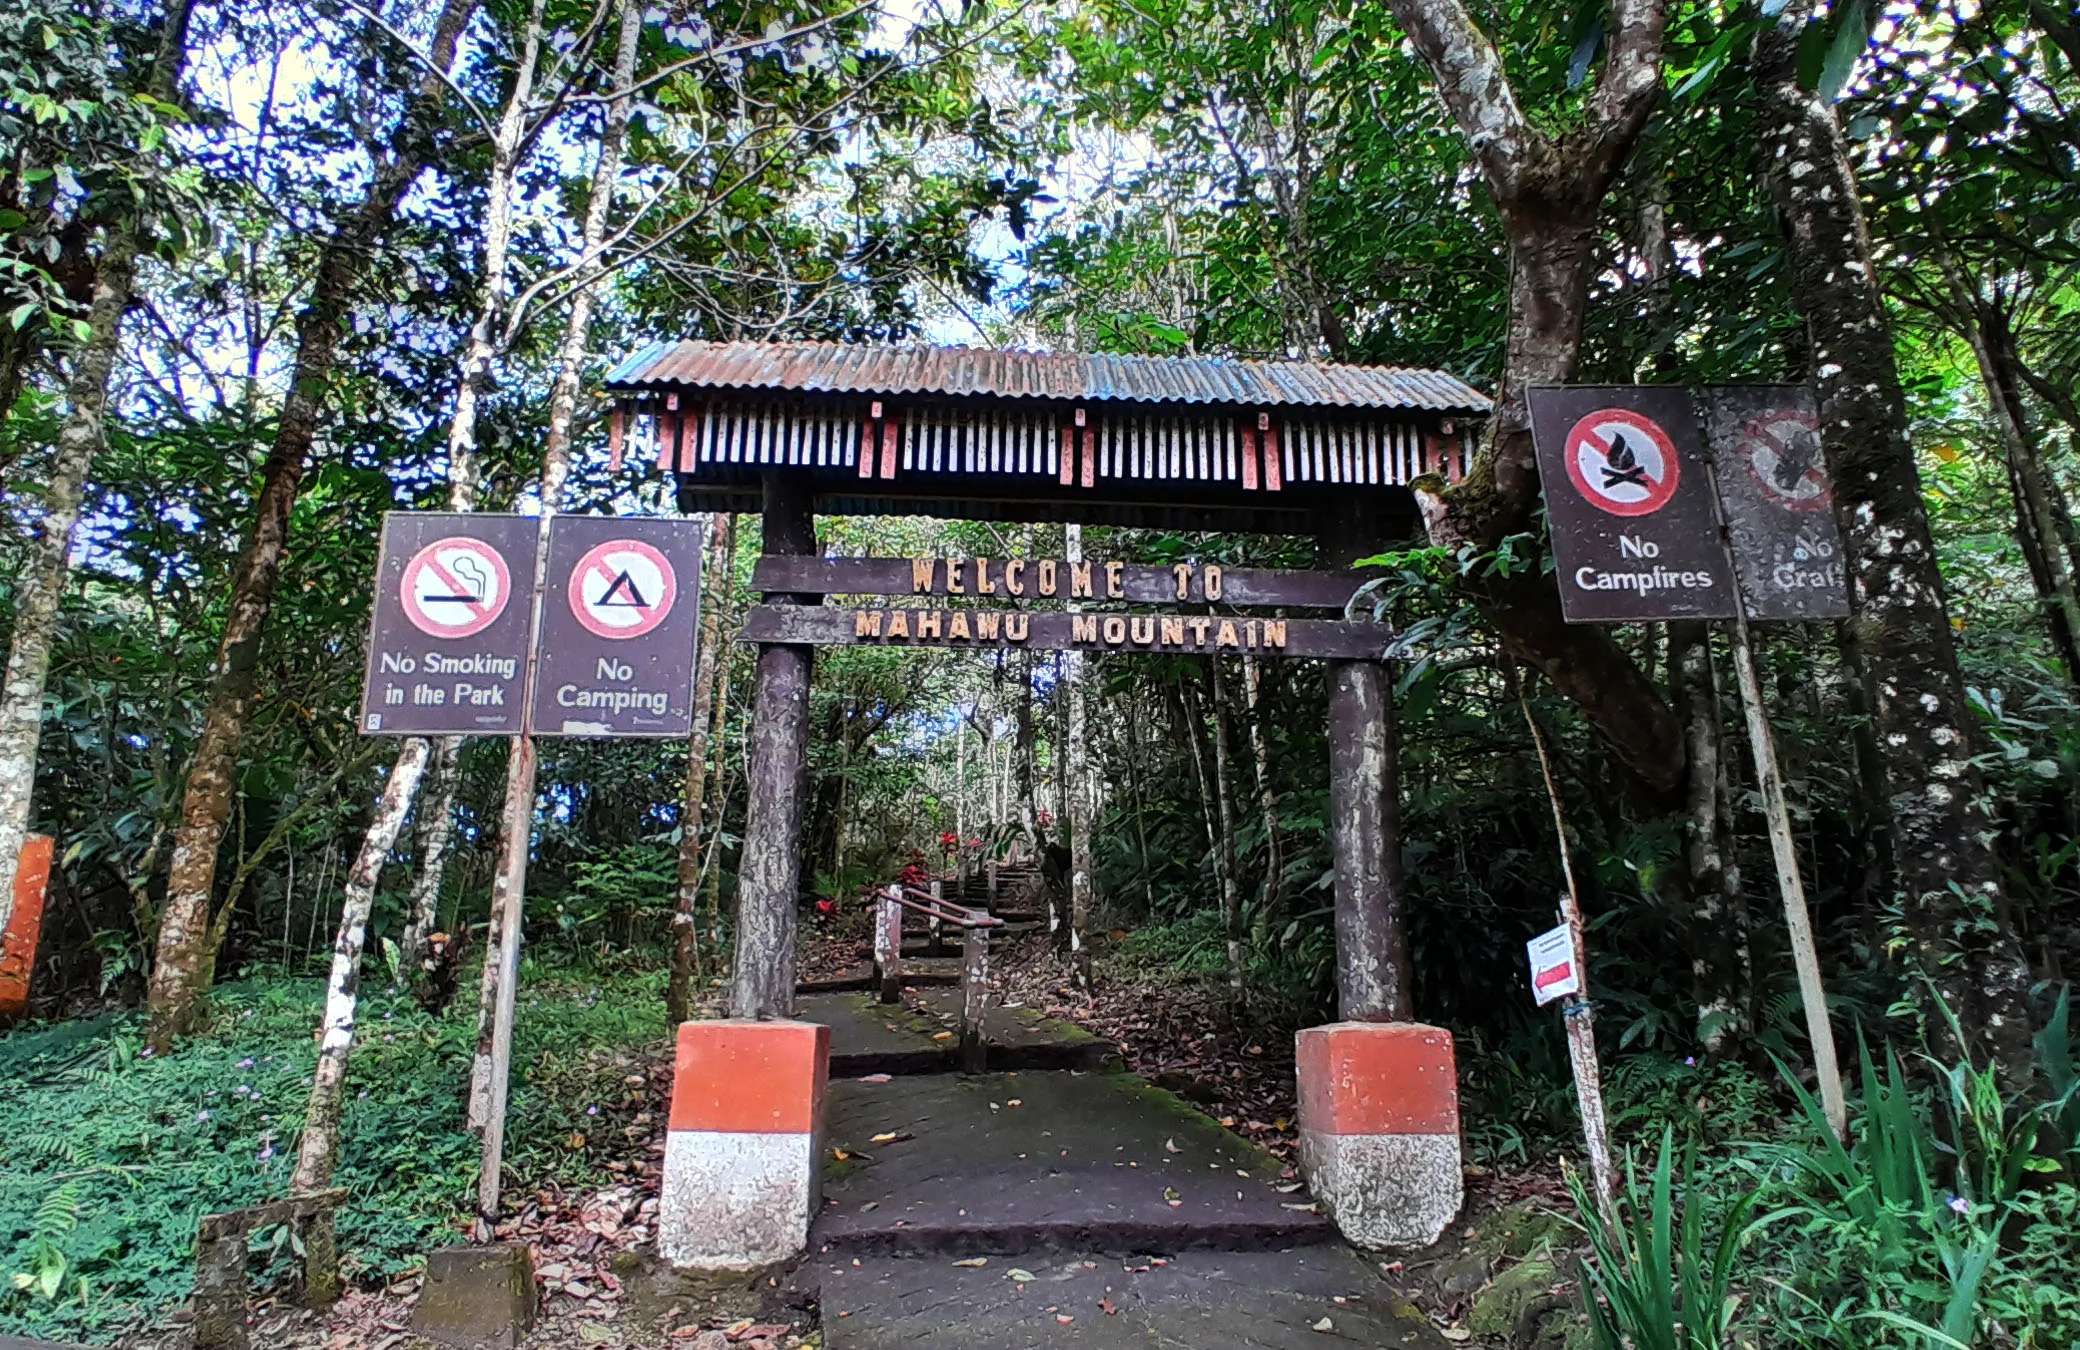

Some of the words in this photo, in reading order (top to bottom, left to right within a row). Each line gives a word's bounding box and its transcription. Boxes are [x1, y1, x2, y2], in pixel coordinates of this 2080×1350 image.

[1619, 535, 1659, 559] No
[1794, 533, 1834, 557] No
[912, 558, 1125, 598] WELCOME
[1173, 563, 1223, 602] TO
[1575, 566, 1713, 597] Campfires
[855, 610, 1030, 641] MAHAWU
[1072, 613, 1287, 648] MOUNTAIN
[380, 652, 415, 674] No
[423, 652, 516, 679] Smoking
[596, 658, 633, 681] No
[385, 683, 404, 705] in
[414, 684, 445, 705] the
[454, 684, 504, 706] Park
[557, 685, 668, 715] Camping
